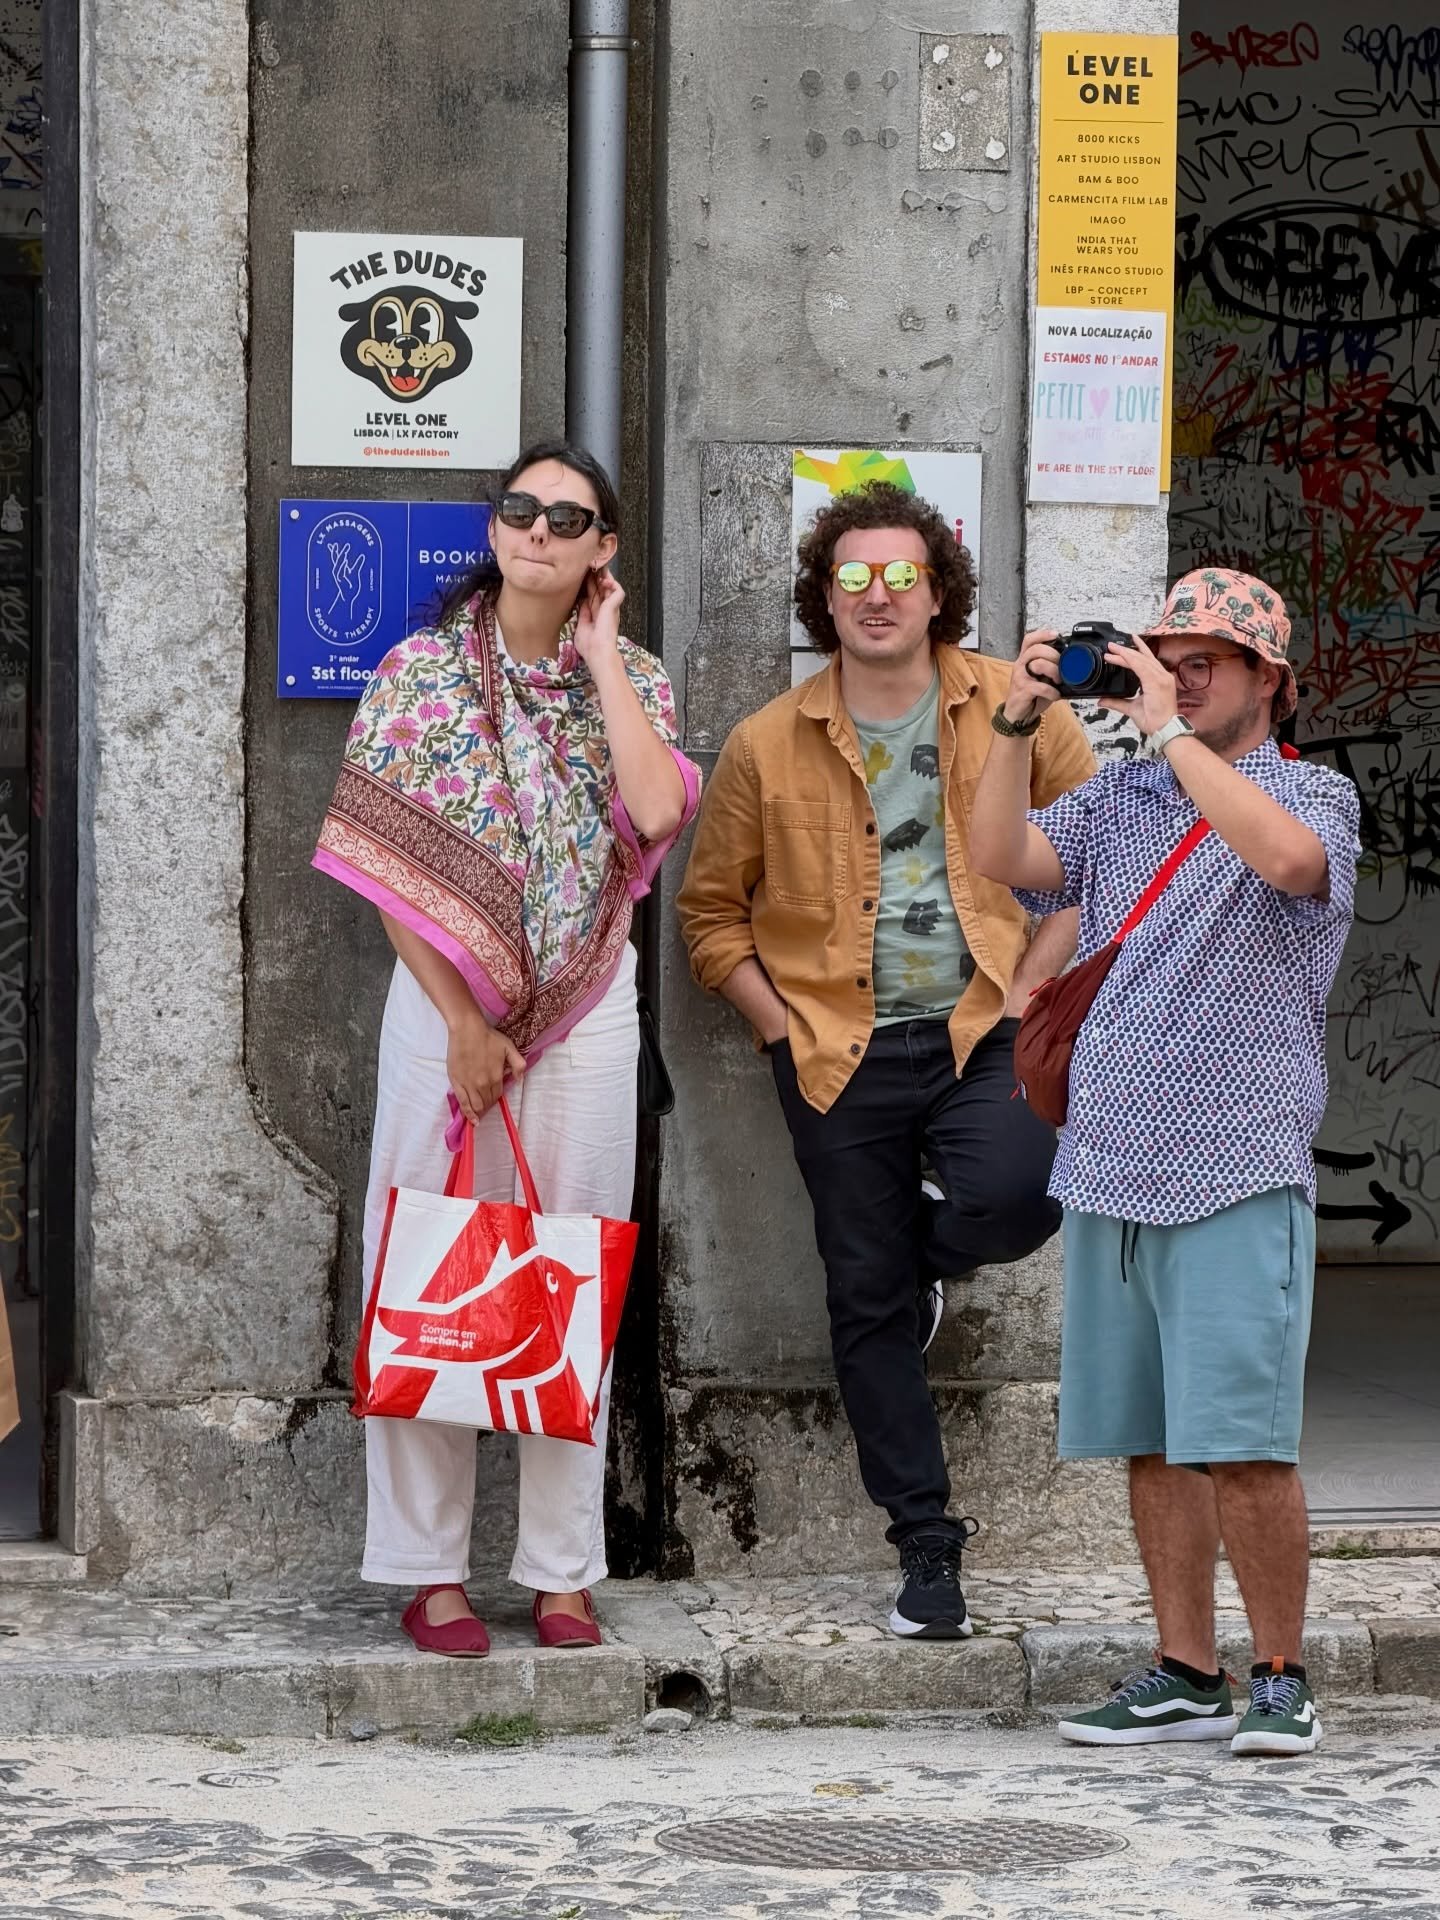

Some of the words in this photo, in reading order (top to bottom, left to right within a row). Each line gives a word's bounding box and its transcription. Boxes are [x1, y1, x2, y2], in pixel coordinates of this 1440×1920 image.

[1067, 54, 1153, 78] LEVEL
[1079, 83, 1140, 105] ONE
[1078, 134, 1105, 143] 8000
[1108, 136, 1140, 144] KICKS
[1056, 154, 1077, 163] ART
[1080, 155, 1120, 164] STUDIO
[1124, 156, 1161, 165] LISBON
[1078, 176, 1102, 184] BAM
[1105, 176, 1113, 184] &
[1116, 176, 1139, 184] BOO
[1048, 194, 1119, 204] CARMENCITA
[1122, 196, 1145, 205] FILM
[1149, 197, 1168, 206] LAB
[1090, 216, 1126, 224] IMAGO
[1077, 236, 1106, 244] INDIA
[1110, 236, 1137, 245] THAT
[1076, 246, 1113, 254] WEARS
[1116, 246, 1139, 255] YOU
[329, 251, 387, 290] THE
[393, 250, 487, 296] DUDES
[1050, 264, 1074, 274] INÊS
[1078, 266, 1121, 275] FRANCO
[1125, 267, 1164, 276] STUDIO
[1066, 286, 1084, 294] LBP
[1098, 286, 1148, 296] CONCEPT
[1090, 296, 1123, 305] STORE
[1048, 326, 1078, 337] NOVA
[1081, 326, 1152, 342] LOCALIZAÇÃO
[1043, 352, 1092, 364] ESTAMOS
[1094, 354, 1108, 365] NO
[1035, 382, 1086, 422] PETIT
[1115, 384, 1160, 423] LOVE
[366, 412, 410, 426] LEVEL
[415, 414, 448, 426] ONE
[353, 428, 390, 438] LISBOA
[396, 430, 409, 438] LX
[412, 430, 459, 439] FACTORY
[363, 447, 450, 457] @thedudeslisbon
[1036, 463, 1050, 472] WE
[1053, 464, 1072, 473] ARE
[1074, 464, 1084, 473] IN
[1088, 464, 1106, 474] THE
[1128, 466, 1155, 476] FLOOR
[316, 531, 326, 545] LX
[325, 519, 375, 547] MASSAGENS
[314, 607, 338, 638] SPORTS
[344, 606, 375, 640] THERAPY
[338, 655, 360, 663] andar
[312, 666, 336, 680] 3st
[420, 1322, 460, 1338] Compre
[461, 1330, 476, 1340] em
[419, 1334, 474, 1351] auchan.pt
